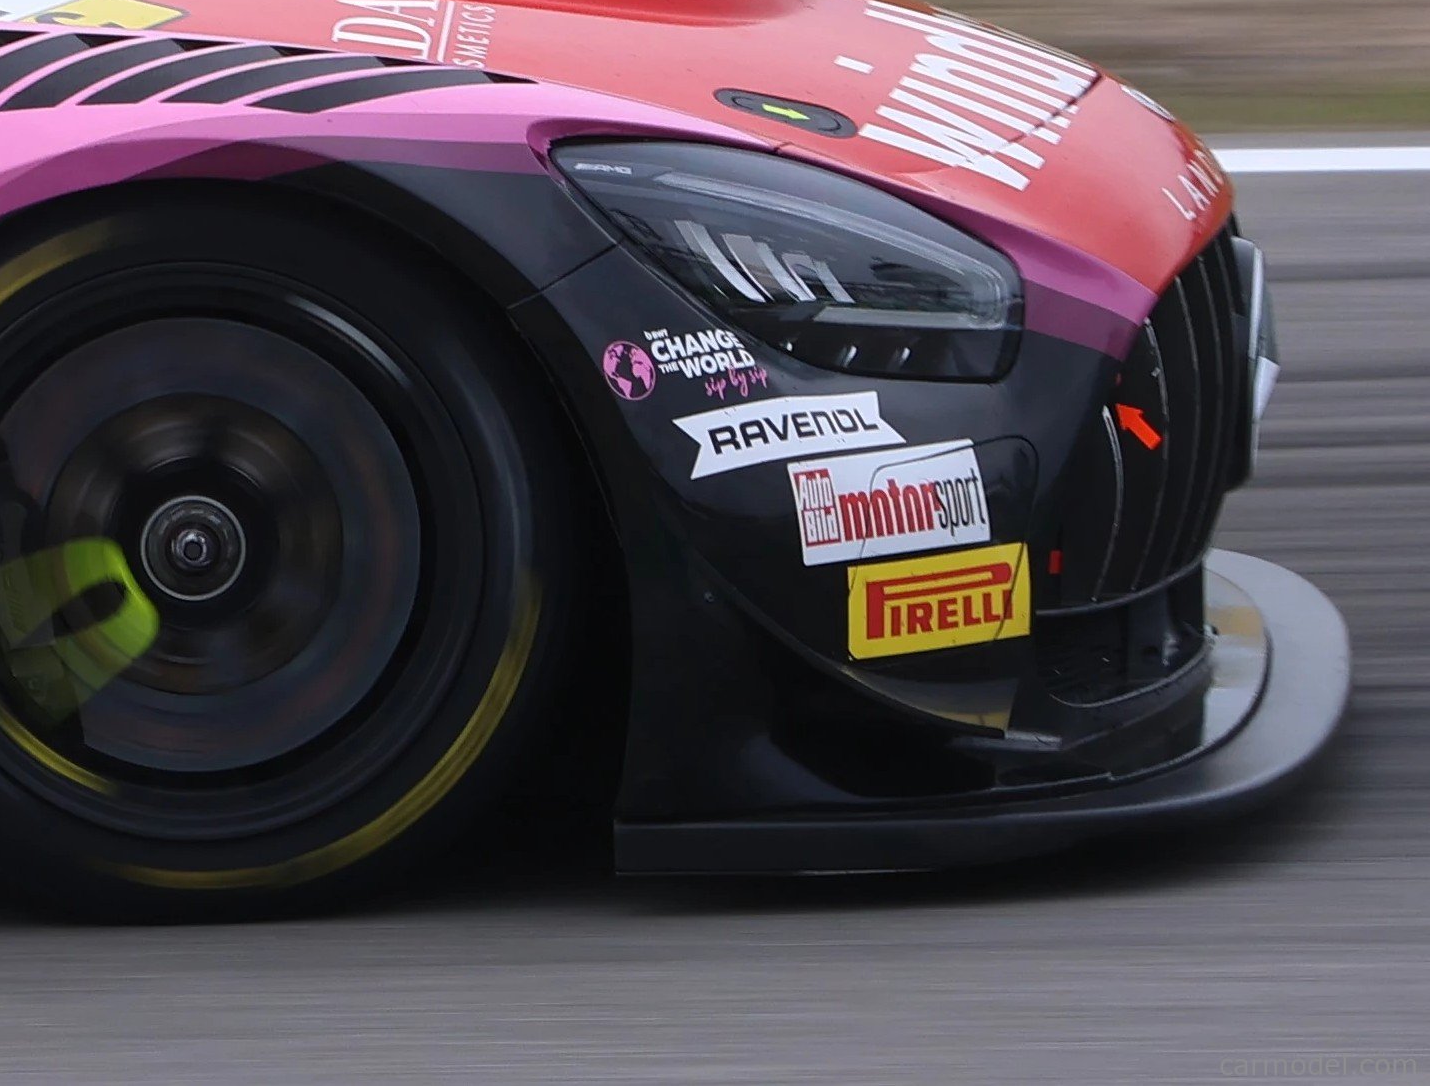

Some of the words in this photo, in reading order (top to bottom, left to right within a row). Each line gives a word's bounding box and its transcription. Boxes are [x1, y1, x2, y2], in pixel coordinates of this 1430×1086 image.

[650, 328, 745, 362] CHANGE
[658, 363, 679, 375] THE
[678, 350, 756, 379] WORLD
[705, 377, 726, 400] sip
[728, 369, 749, 398] by
[749, 367, 768, 388] sip
[707, 408, 879, 454] RAVENOL
[866, 561, 1013, 640] PIRELLI
